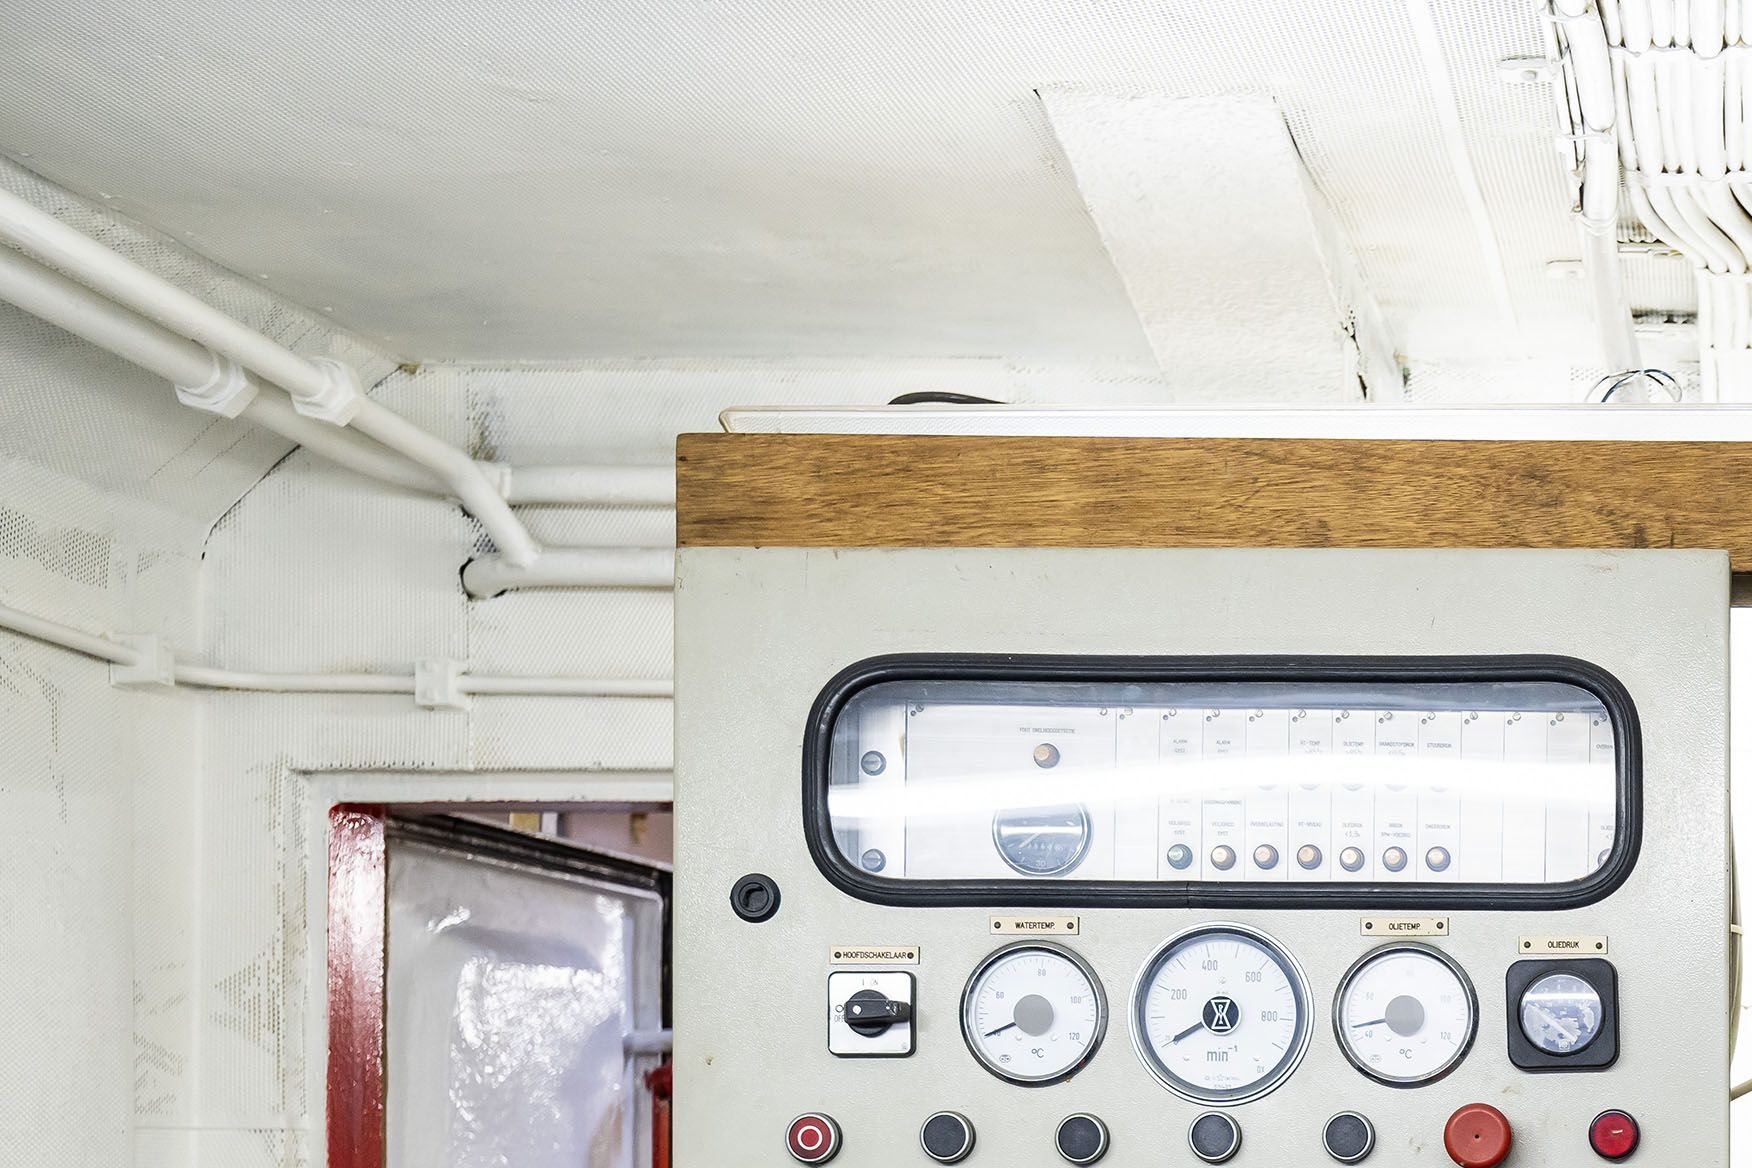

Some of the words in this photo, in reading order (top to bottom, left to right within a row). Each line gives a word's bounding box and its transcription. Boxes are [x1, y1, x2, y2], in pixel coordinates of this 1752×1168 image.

[1548, 941, 1580, 949] OLIEDRUK
[843, 952, 907, 960] HOOFDSCHAKELAAR
[1202, 960, 1218, 971] 400
[1245, 972, 1261, 982] 600
[1171, 989, 1187, 1000] 200
[1261, 1011, 1277, 1022] 800
[1032, 1048, 1044, 1058] °C
[1400, 1049, 1412, 1060] °C
